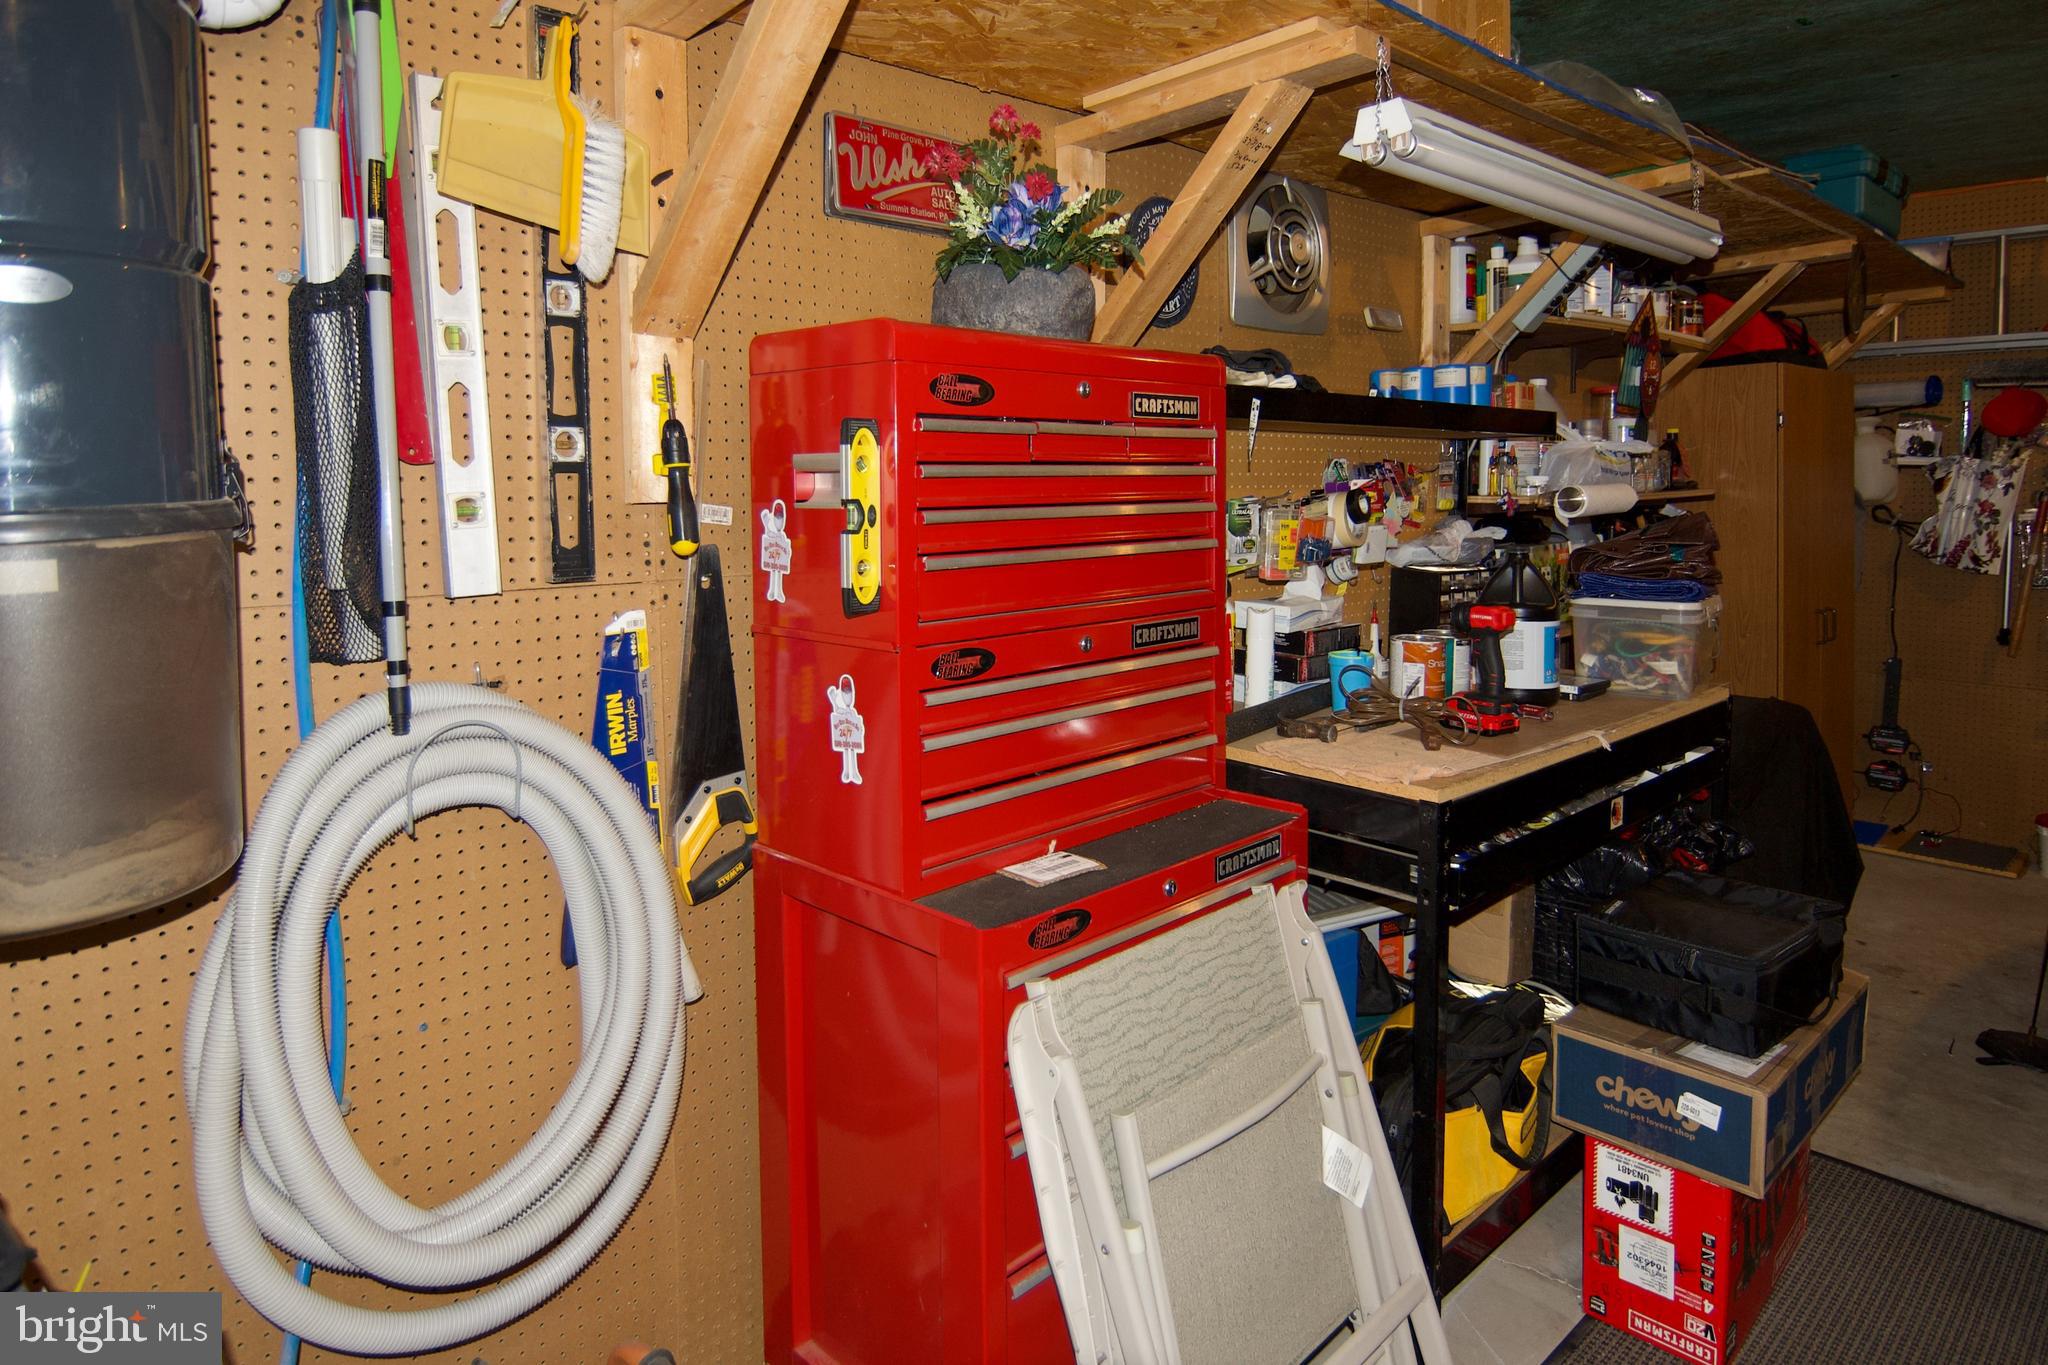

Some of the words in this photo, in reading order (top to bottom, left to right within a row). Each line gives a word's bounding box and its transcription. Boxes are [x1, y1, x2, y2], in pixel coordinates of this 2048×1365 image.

[849, 129, 878, 145] JOHN
[882, 128, 899, 139] Pine
[900, 133, 924, 146] Grove,
[925, 138, 935, 147] PA
[931, 187, 956, 200] AUTO
[880, 201, 909, 214] Summit
[910, 206, 937, 219] Station,
[939, 212, 949, 221] PA
[1138, 210, 1151, 228] YOU
[937, 374, 959, 387] BALL
[934, 387, 973, 402] BEARING
[1135, 397, 1198, 416] CRAFTSMAN
[1135, 621, 1198, 644] CRAFTSMAN
[938, 651, 960, 667] BALL
[935, 664, 974, 680] BEARING
[606, 692, 628, 756] IRWIN
[627, 698, 639, 743] Marples
[1218, 840, 1281, 877] CRAFTSMAN
[1035, 919, 1057, 934] BALL
[1033, 926, 1070, 950] BEARING
[1603, 1103, 1630, 1117] where
[1646, 1116, 1673, 1132] lovers
[1673, 1127, 1696, 1141] shop
[1617, 1162, 1650, 1183] UN3481
[1633, 1317, 1712, 1361] CRAFTSMAN
